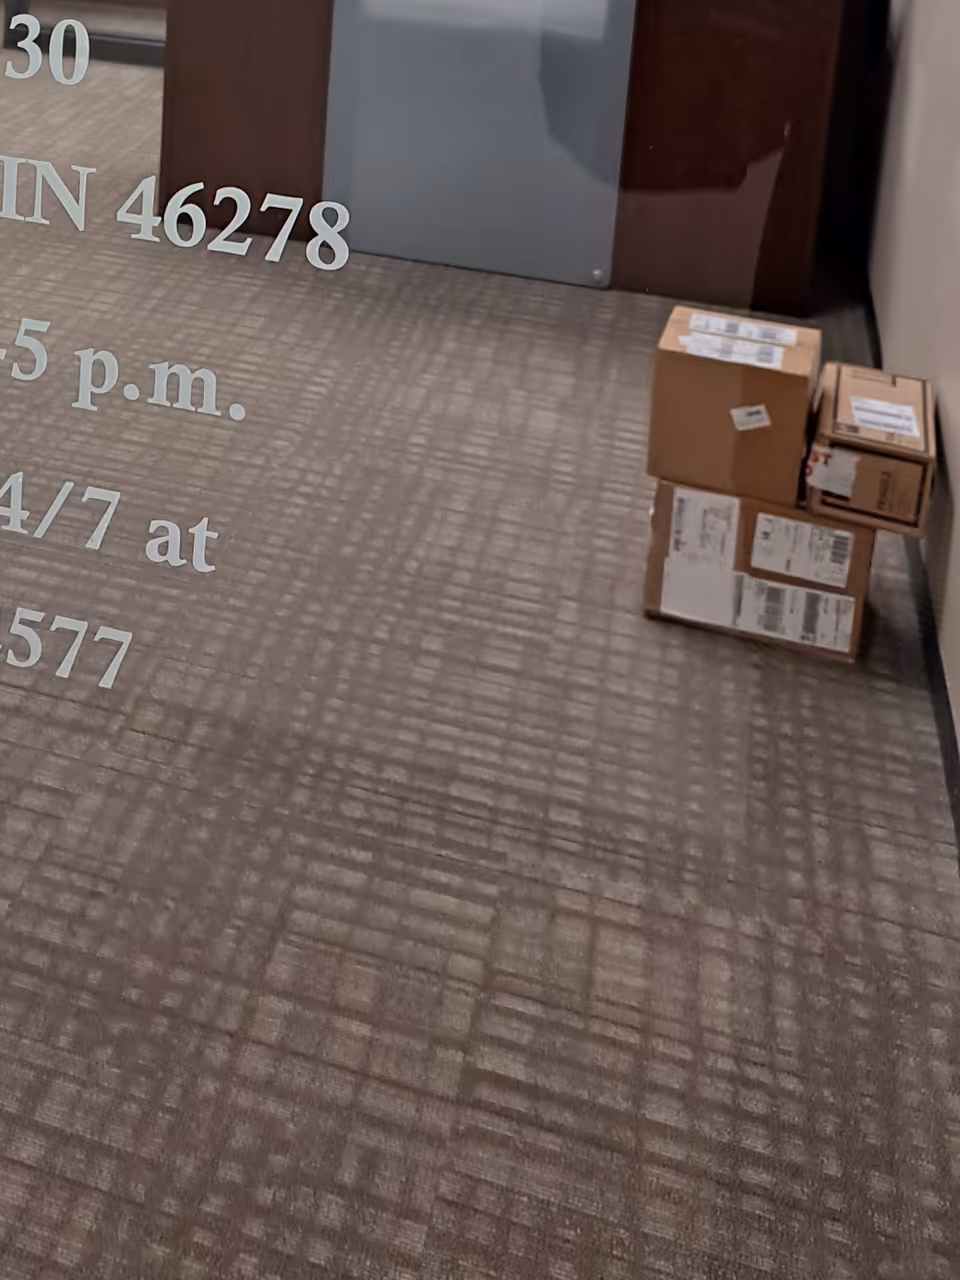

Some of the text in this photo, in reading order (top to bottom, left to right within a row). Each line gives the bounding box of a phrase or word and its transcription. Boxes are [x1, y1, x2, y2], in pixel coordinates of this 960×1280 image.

[116, 175, 352, 271] 46278
[72, 345, 247, 421] p.m.
[144, 516, 220, 574] at
